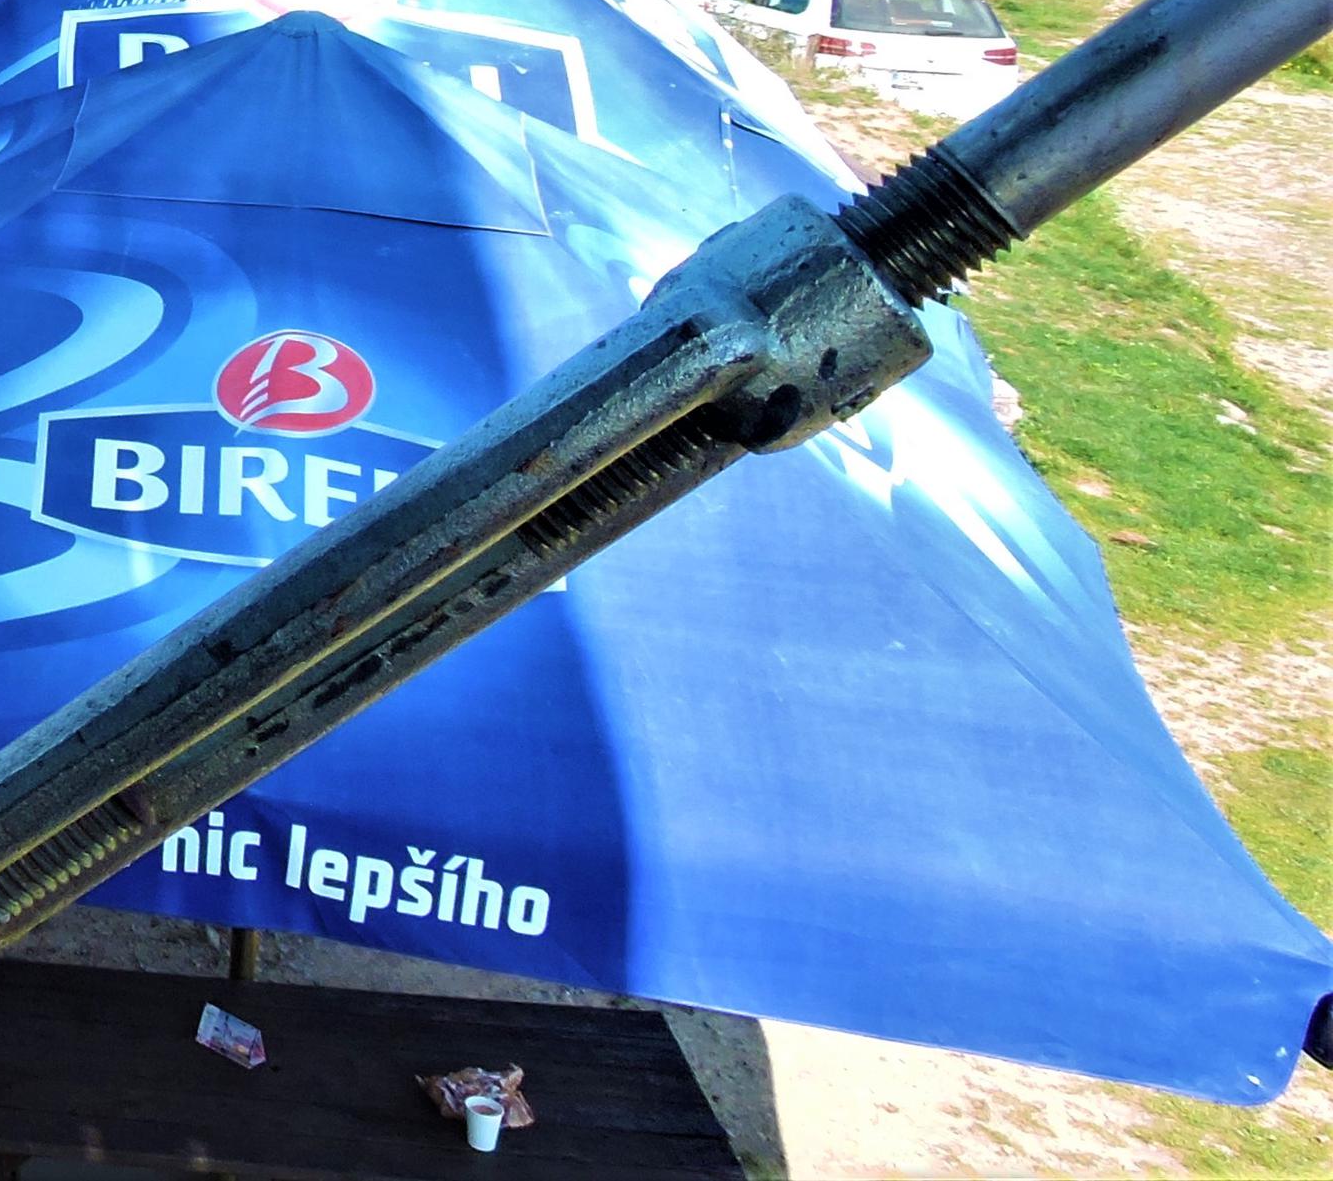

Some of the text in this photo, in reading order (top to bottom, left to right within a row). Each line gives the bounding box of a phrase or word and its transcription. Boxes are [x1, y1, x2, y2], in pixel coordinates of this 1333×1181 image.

[91, 438, 398, 528] BIRE
[161, 811, 550, 937] nic lepšího
